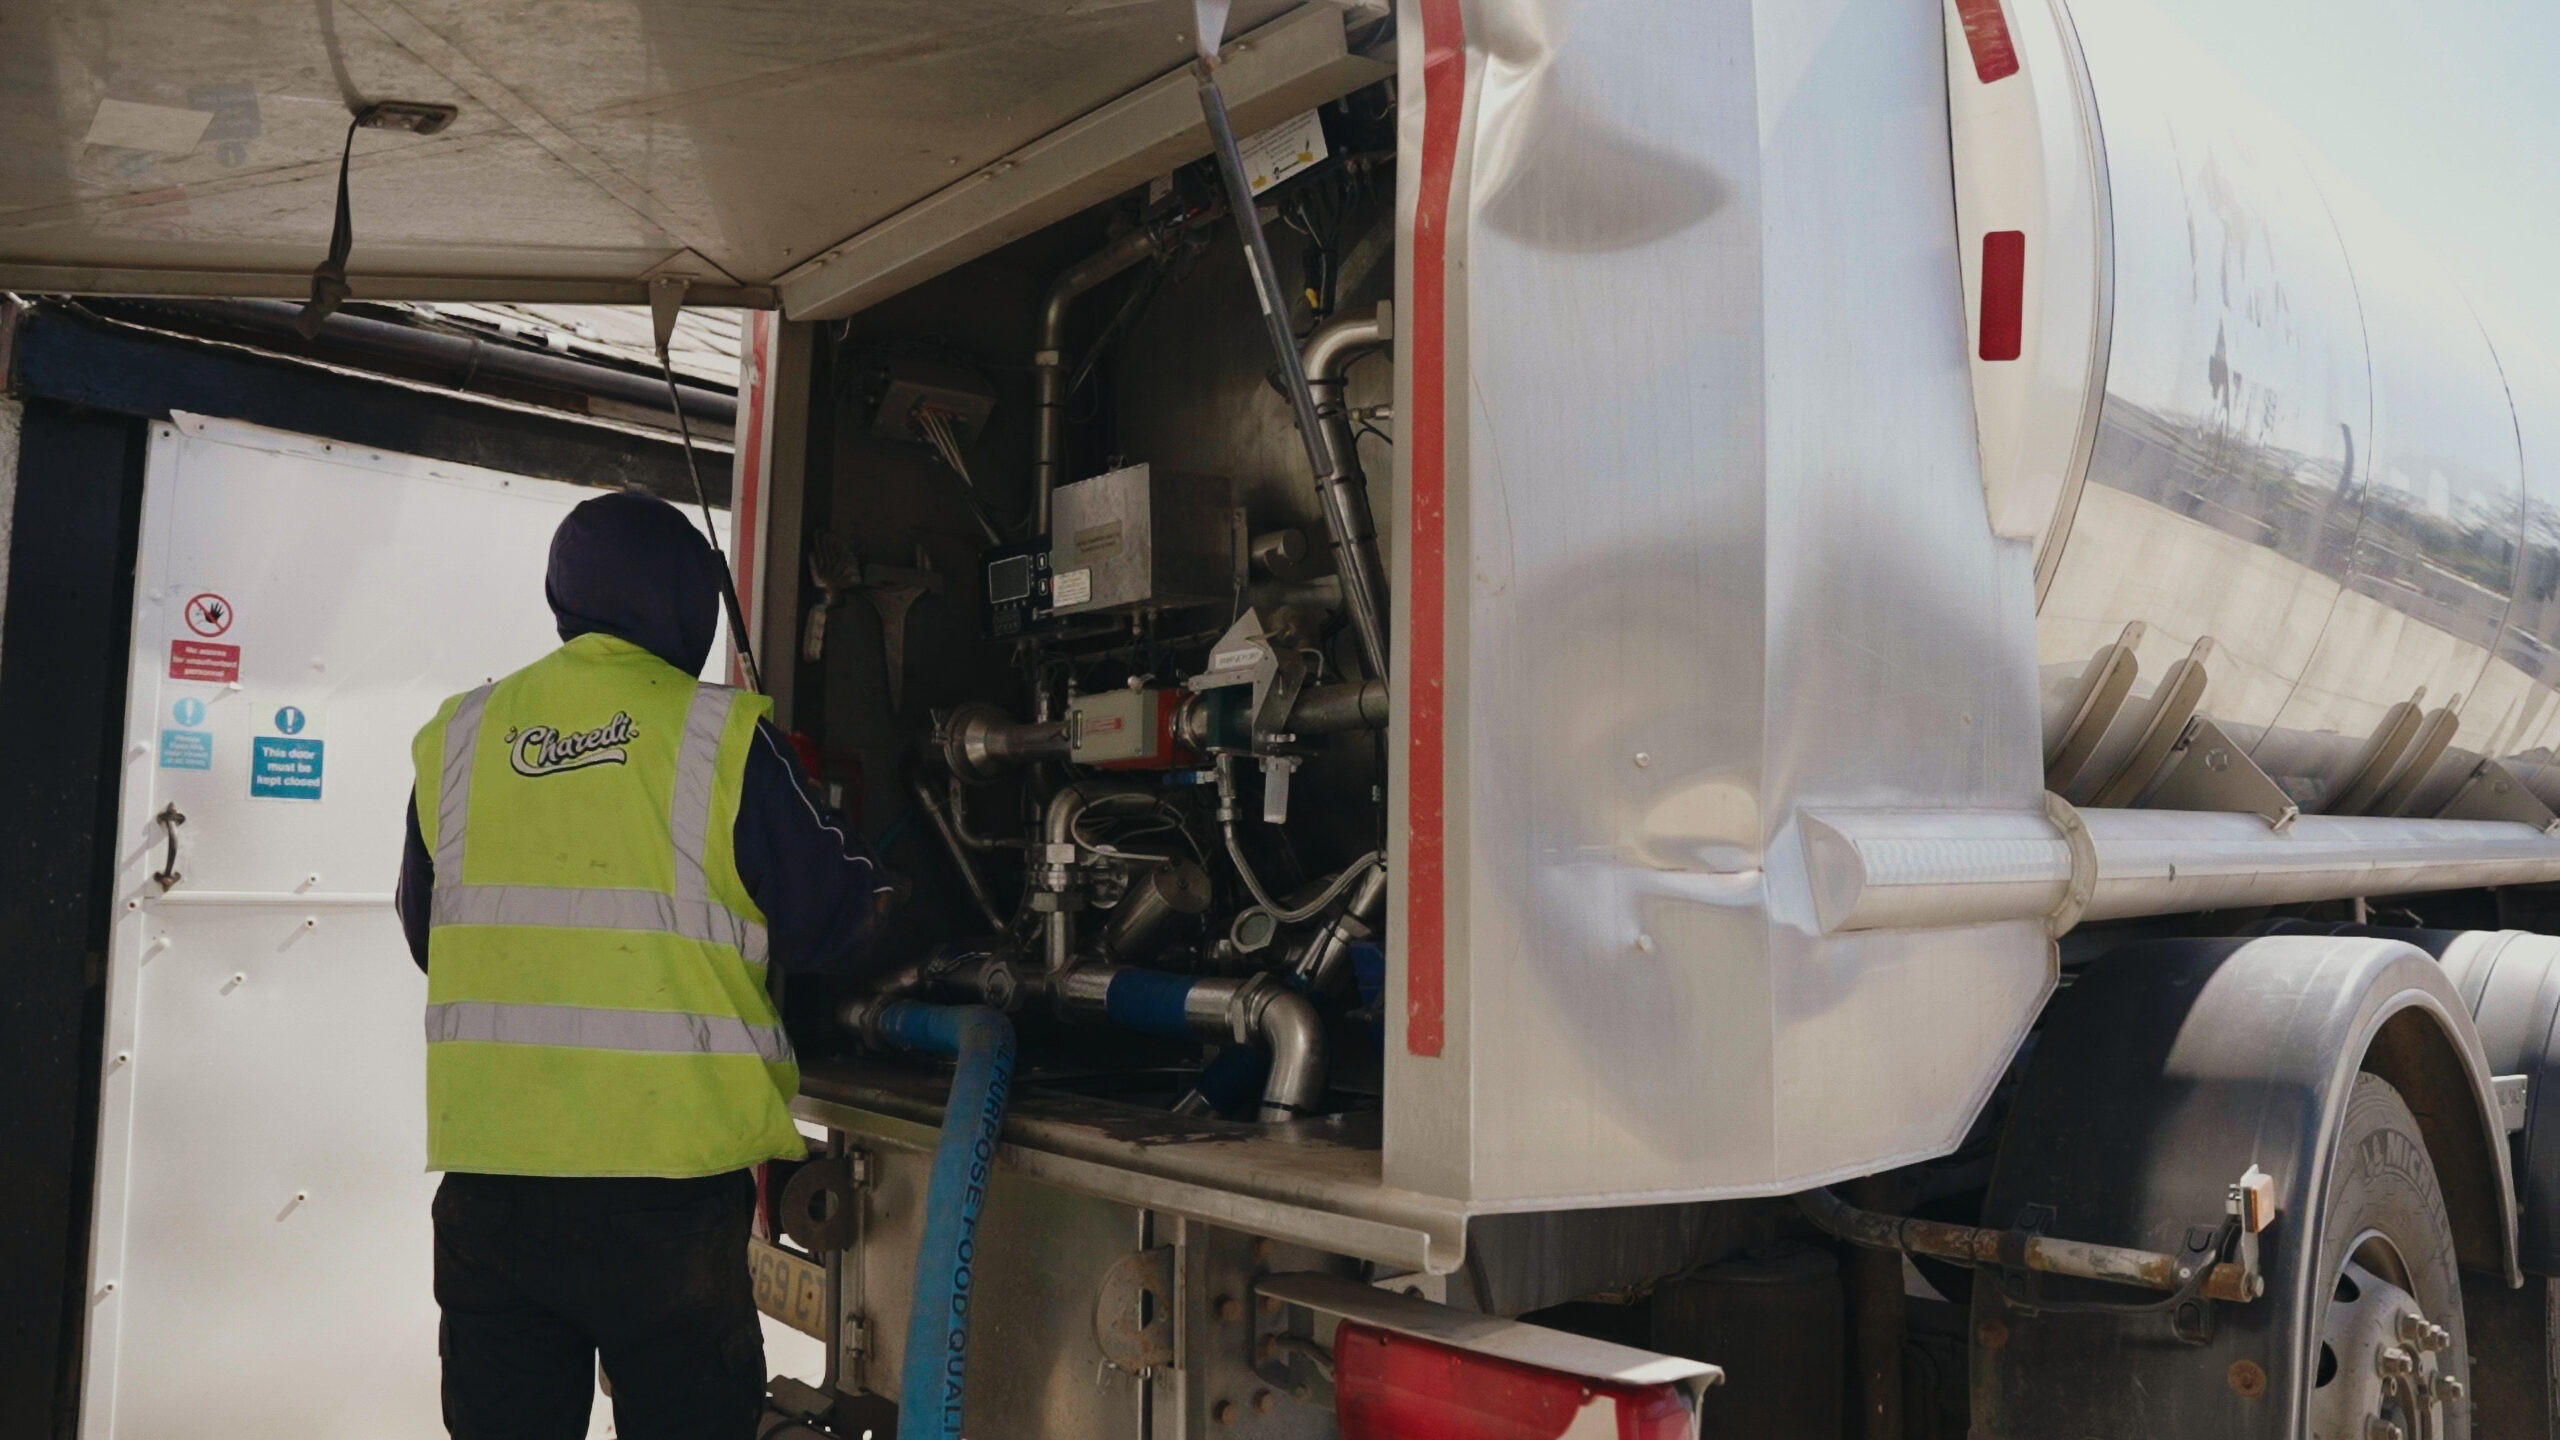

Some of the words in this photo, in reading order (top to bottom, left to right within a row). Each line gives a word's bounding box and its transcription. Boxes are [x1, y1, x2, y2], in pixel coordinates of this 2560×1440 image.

[262, 746, 287, 759] This
[288, 747, 316, 760] door
[511, 711, 632, 777] Charedi
[256, 775, 282, 787] kept
[283, 776, 320, 787] closed
[267, 762, 296, 772] must
[297, 762, 312, 773] be
[965, 1064, 1008, 1208] PURPOSE
[952, 1216, 975, 1316] FOOD
